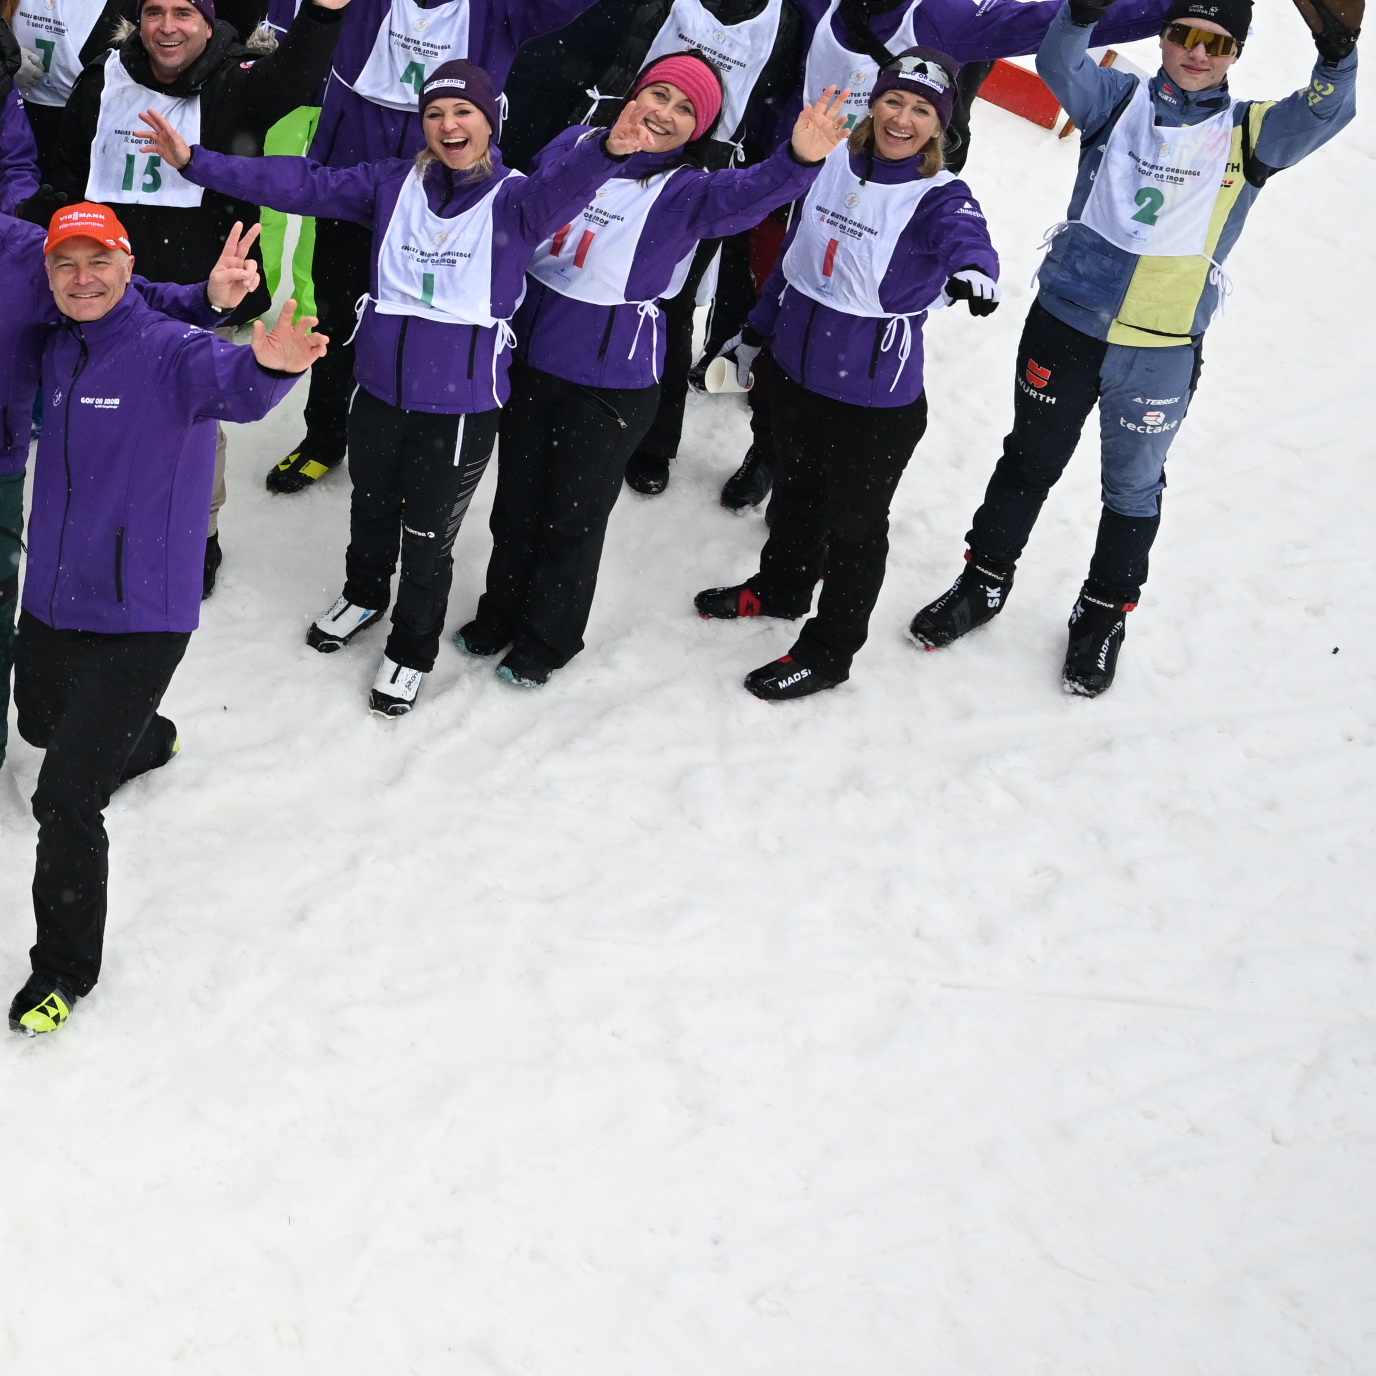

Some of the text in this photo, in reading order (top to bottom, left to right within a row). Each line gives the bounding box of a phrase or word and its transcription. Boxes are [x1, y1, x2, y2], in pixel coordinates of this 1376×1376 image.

[34, 36, 56, 74] 7
[121, 153, 162, 193] 15
[1130, 186, 1165, 226] 2
[1144, 396, 1181, 407] TERREX
[1118, 416, 1179, 435] tectake
